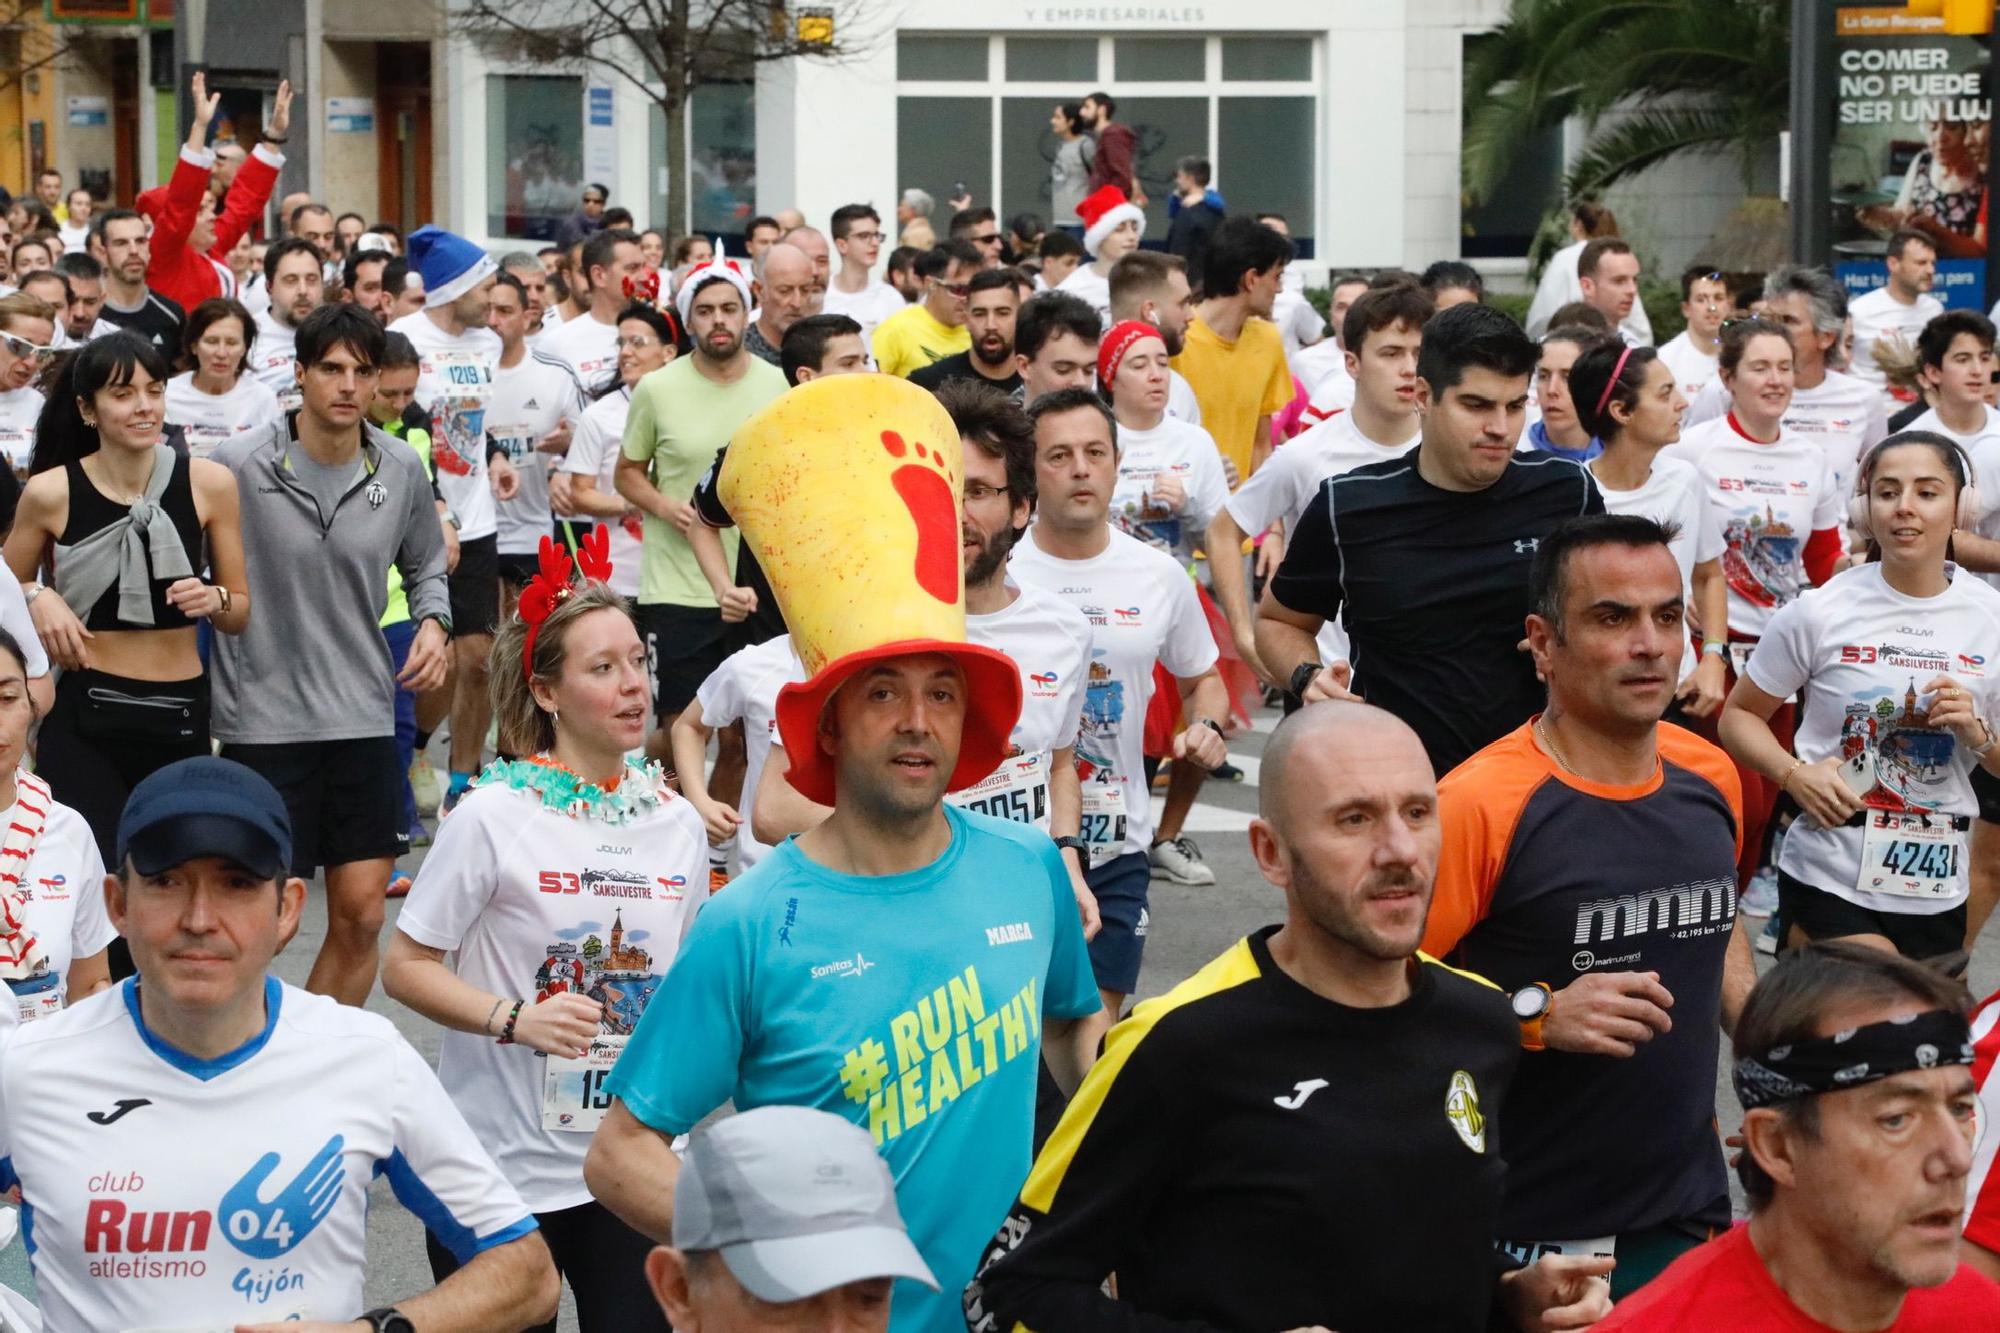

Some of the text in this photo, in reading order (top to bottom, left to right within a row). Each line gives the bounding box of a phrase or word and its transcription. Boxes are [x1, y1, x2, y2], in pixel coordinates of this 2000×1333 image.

[1024, 8, 1205, 22] Y EMPRESARIALES
[1840, 48, 1949, 71] COMER
[1840, 73, 1981, 98] NO PUEDE
[1840, 101, 1892, 123] SER
[1900, 99, 1940, 122] UN
[449, 365, 479, 385] 1219
[1719, 478, 1745, 492] 53
[1840, 646, 1950, 672] 53 SANSILVESTRE
[1882, 840, 1950, 879] 4243
[539, 871, 653, 900] 53 SANSILVESTRE
[985, 922, 1034, 946] MARCA
[1704, 925, 1715, 935] km
[811, 958, 854, 980] Sanitas
[868, 976, 1039, 1148] HEALTHY
[88, 1170, 145, 1193] club
[84, 1198, 214, 1254] Run
[228, 1207, 294, 1249] 04
[89, 1254, 207, 1279] atletismo
[232, 1266, 304, 1304] Gijón
